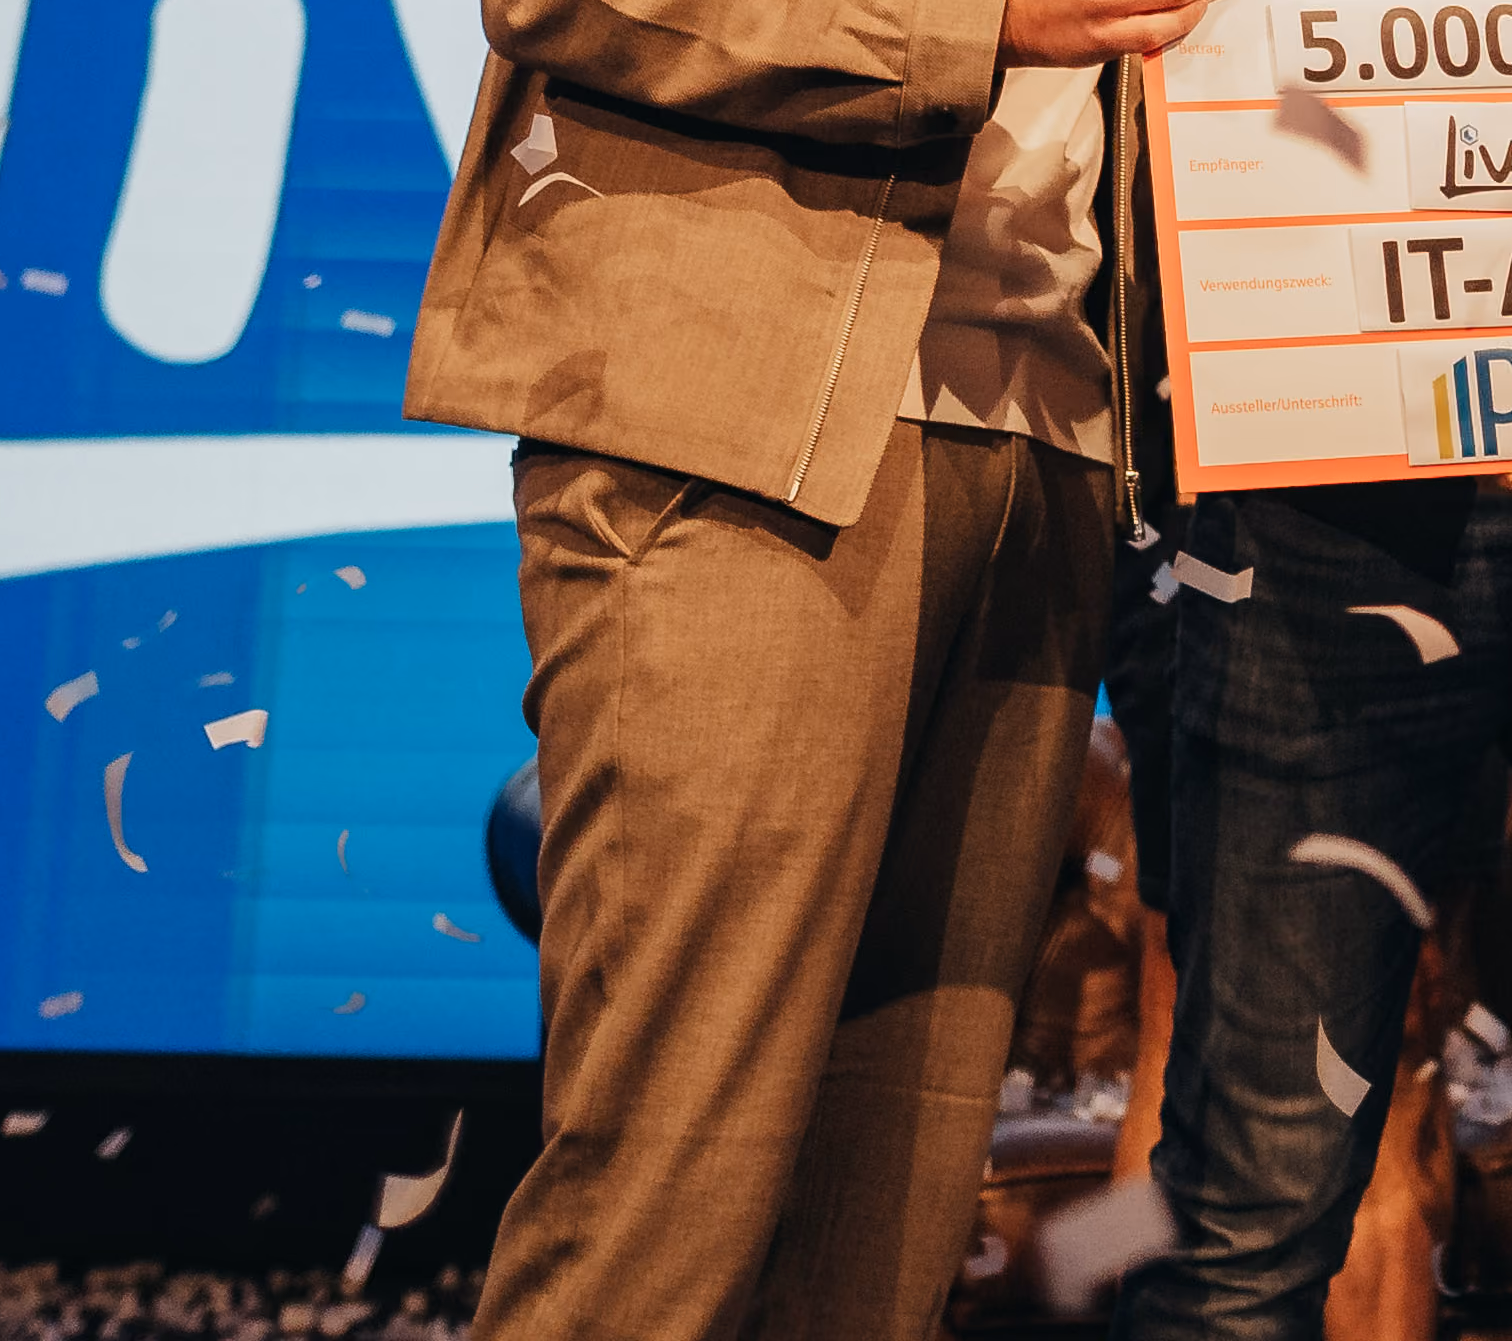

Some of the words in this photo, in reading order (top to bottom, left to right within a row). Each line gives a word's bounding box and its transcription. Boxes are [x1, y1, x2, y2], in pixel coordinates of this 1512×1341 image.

[1178, 42, 1226, 57] Betrag:
[1189, 158, 1264, 174] Empfänger:
[1199, 273, 1333, 292] Verwendungszweck:
[1210, 394, 1363, 416] Aussteller/Unterschrift:
